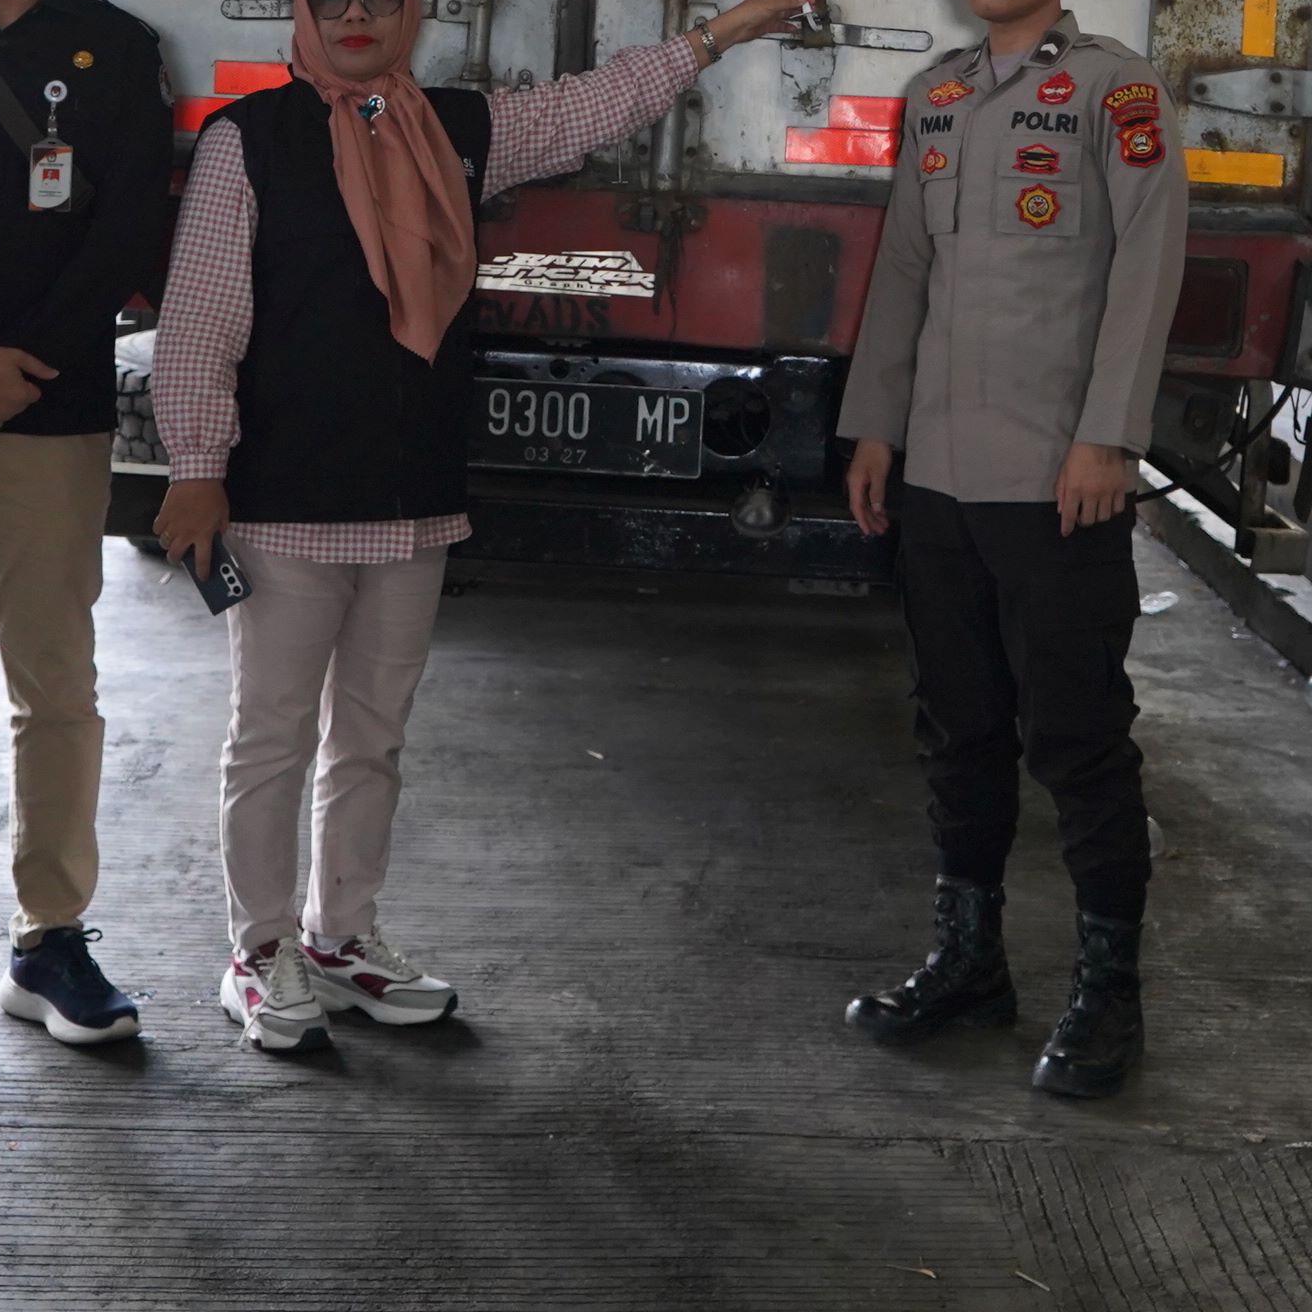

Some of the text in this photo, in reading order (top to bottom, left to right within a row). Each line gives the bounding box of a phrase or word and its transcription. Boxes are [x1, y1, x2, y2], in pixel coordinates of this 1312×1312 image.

[920, 114, 954, 135] IVAN
[1011, 111, 1079, 134] POLRI
[524, 279, 607, 290] Graphic
[488, 388, 690, 444] 9300 MP
[524, 447, 587, 464] 03 27
